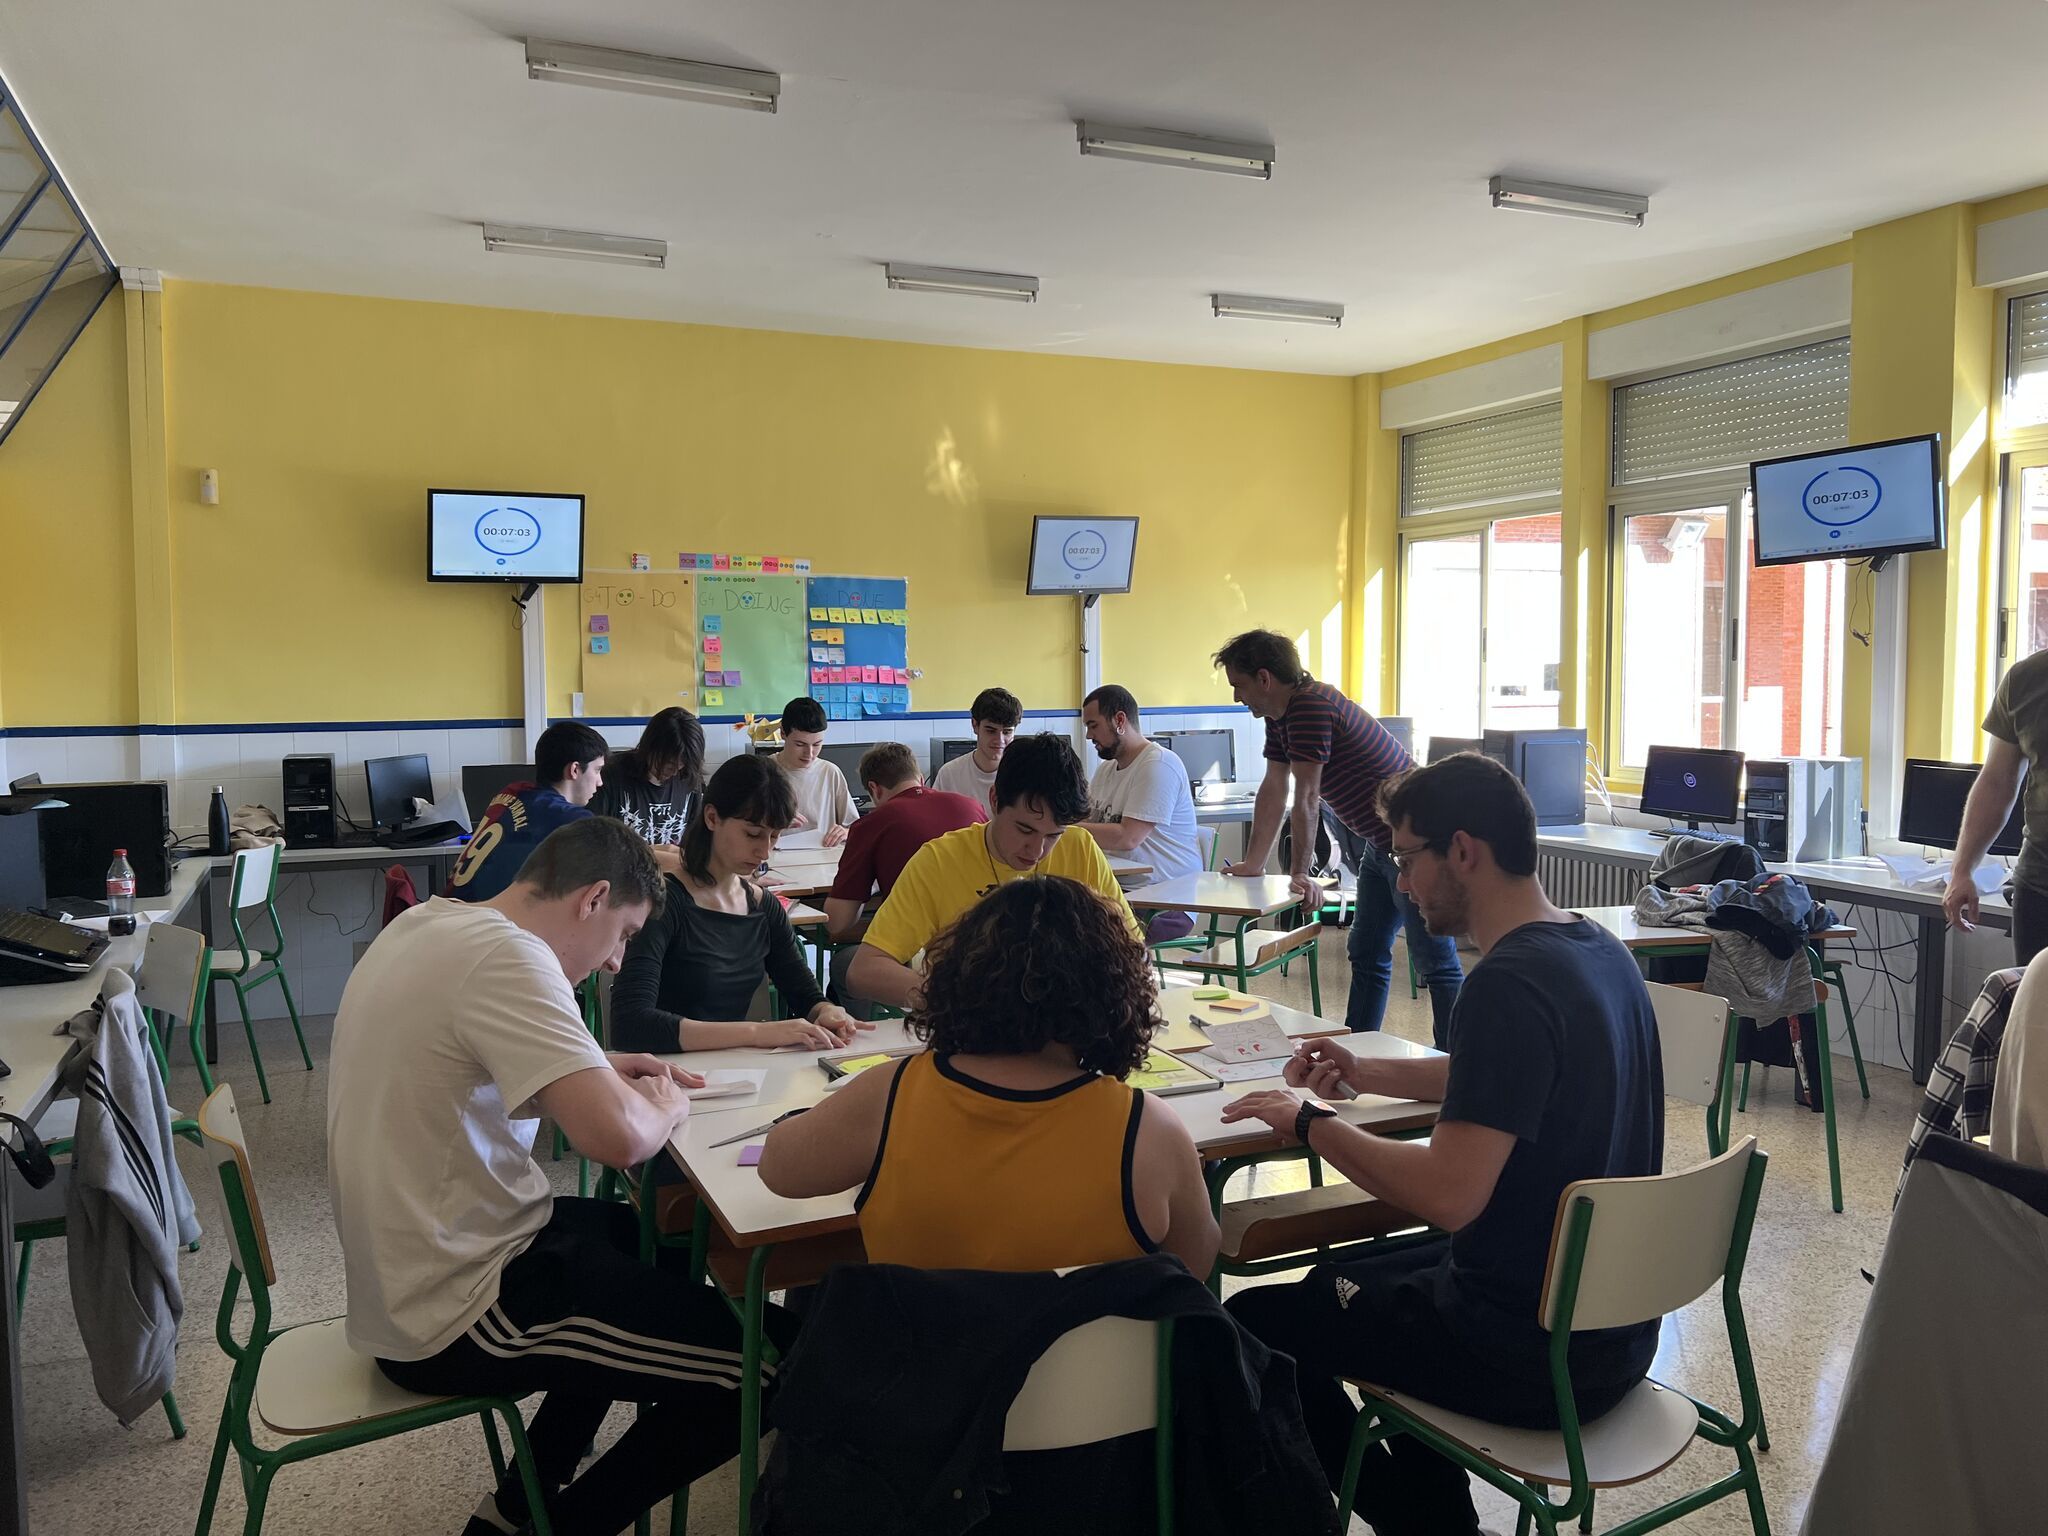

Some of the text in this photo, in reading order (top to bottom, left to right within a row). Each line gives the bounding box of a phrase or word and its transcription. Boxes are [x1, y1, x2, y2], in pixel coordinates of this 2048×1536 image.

[1812, 489, 1869, 505] 00:07:03
[483, 527, 531, 537] 00:07:03
[1068, 547, 1100, 555] 00:07:03
[724, 589, 797, 614] DOING
[838, 590, 885, 608] DONE
